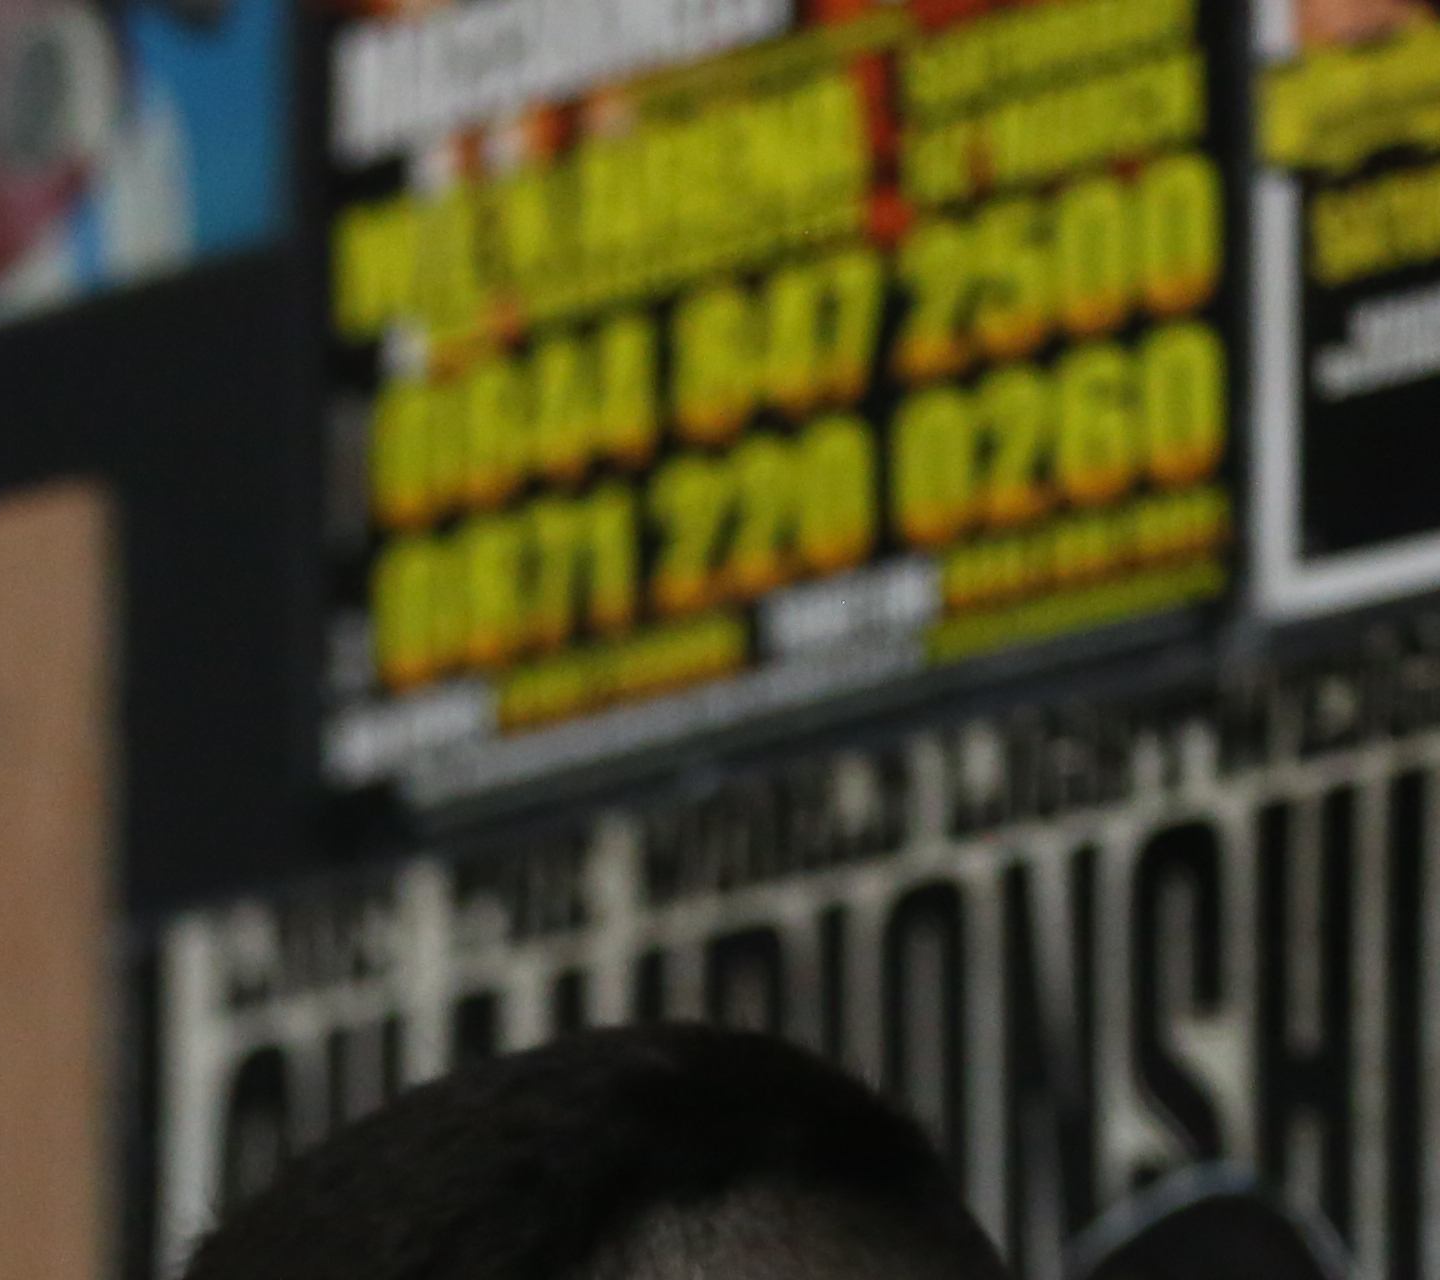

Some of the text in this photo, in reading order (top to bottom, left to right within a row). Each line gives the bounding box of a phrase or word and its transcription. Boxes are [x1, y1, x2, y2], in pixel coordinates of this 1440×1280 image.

[892, 153, 1222, 380] 2500
[650, 414, 876, 615] 220
[893, 322, 1226, 545] 0260
